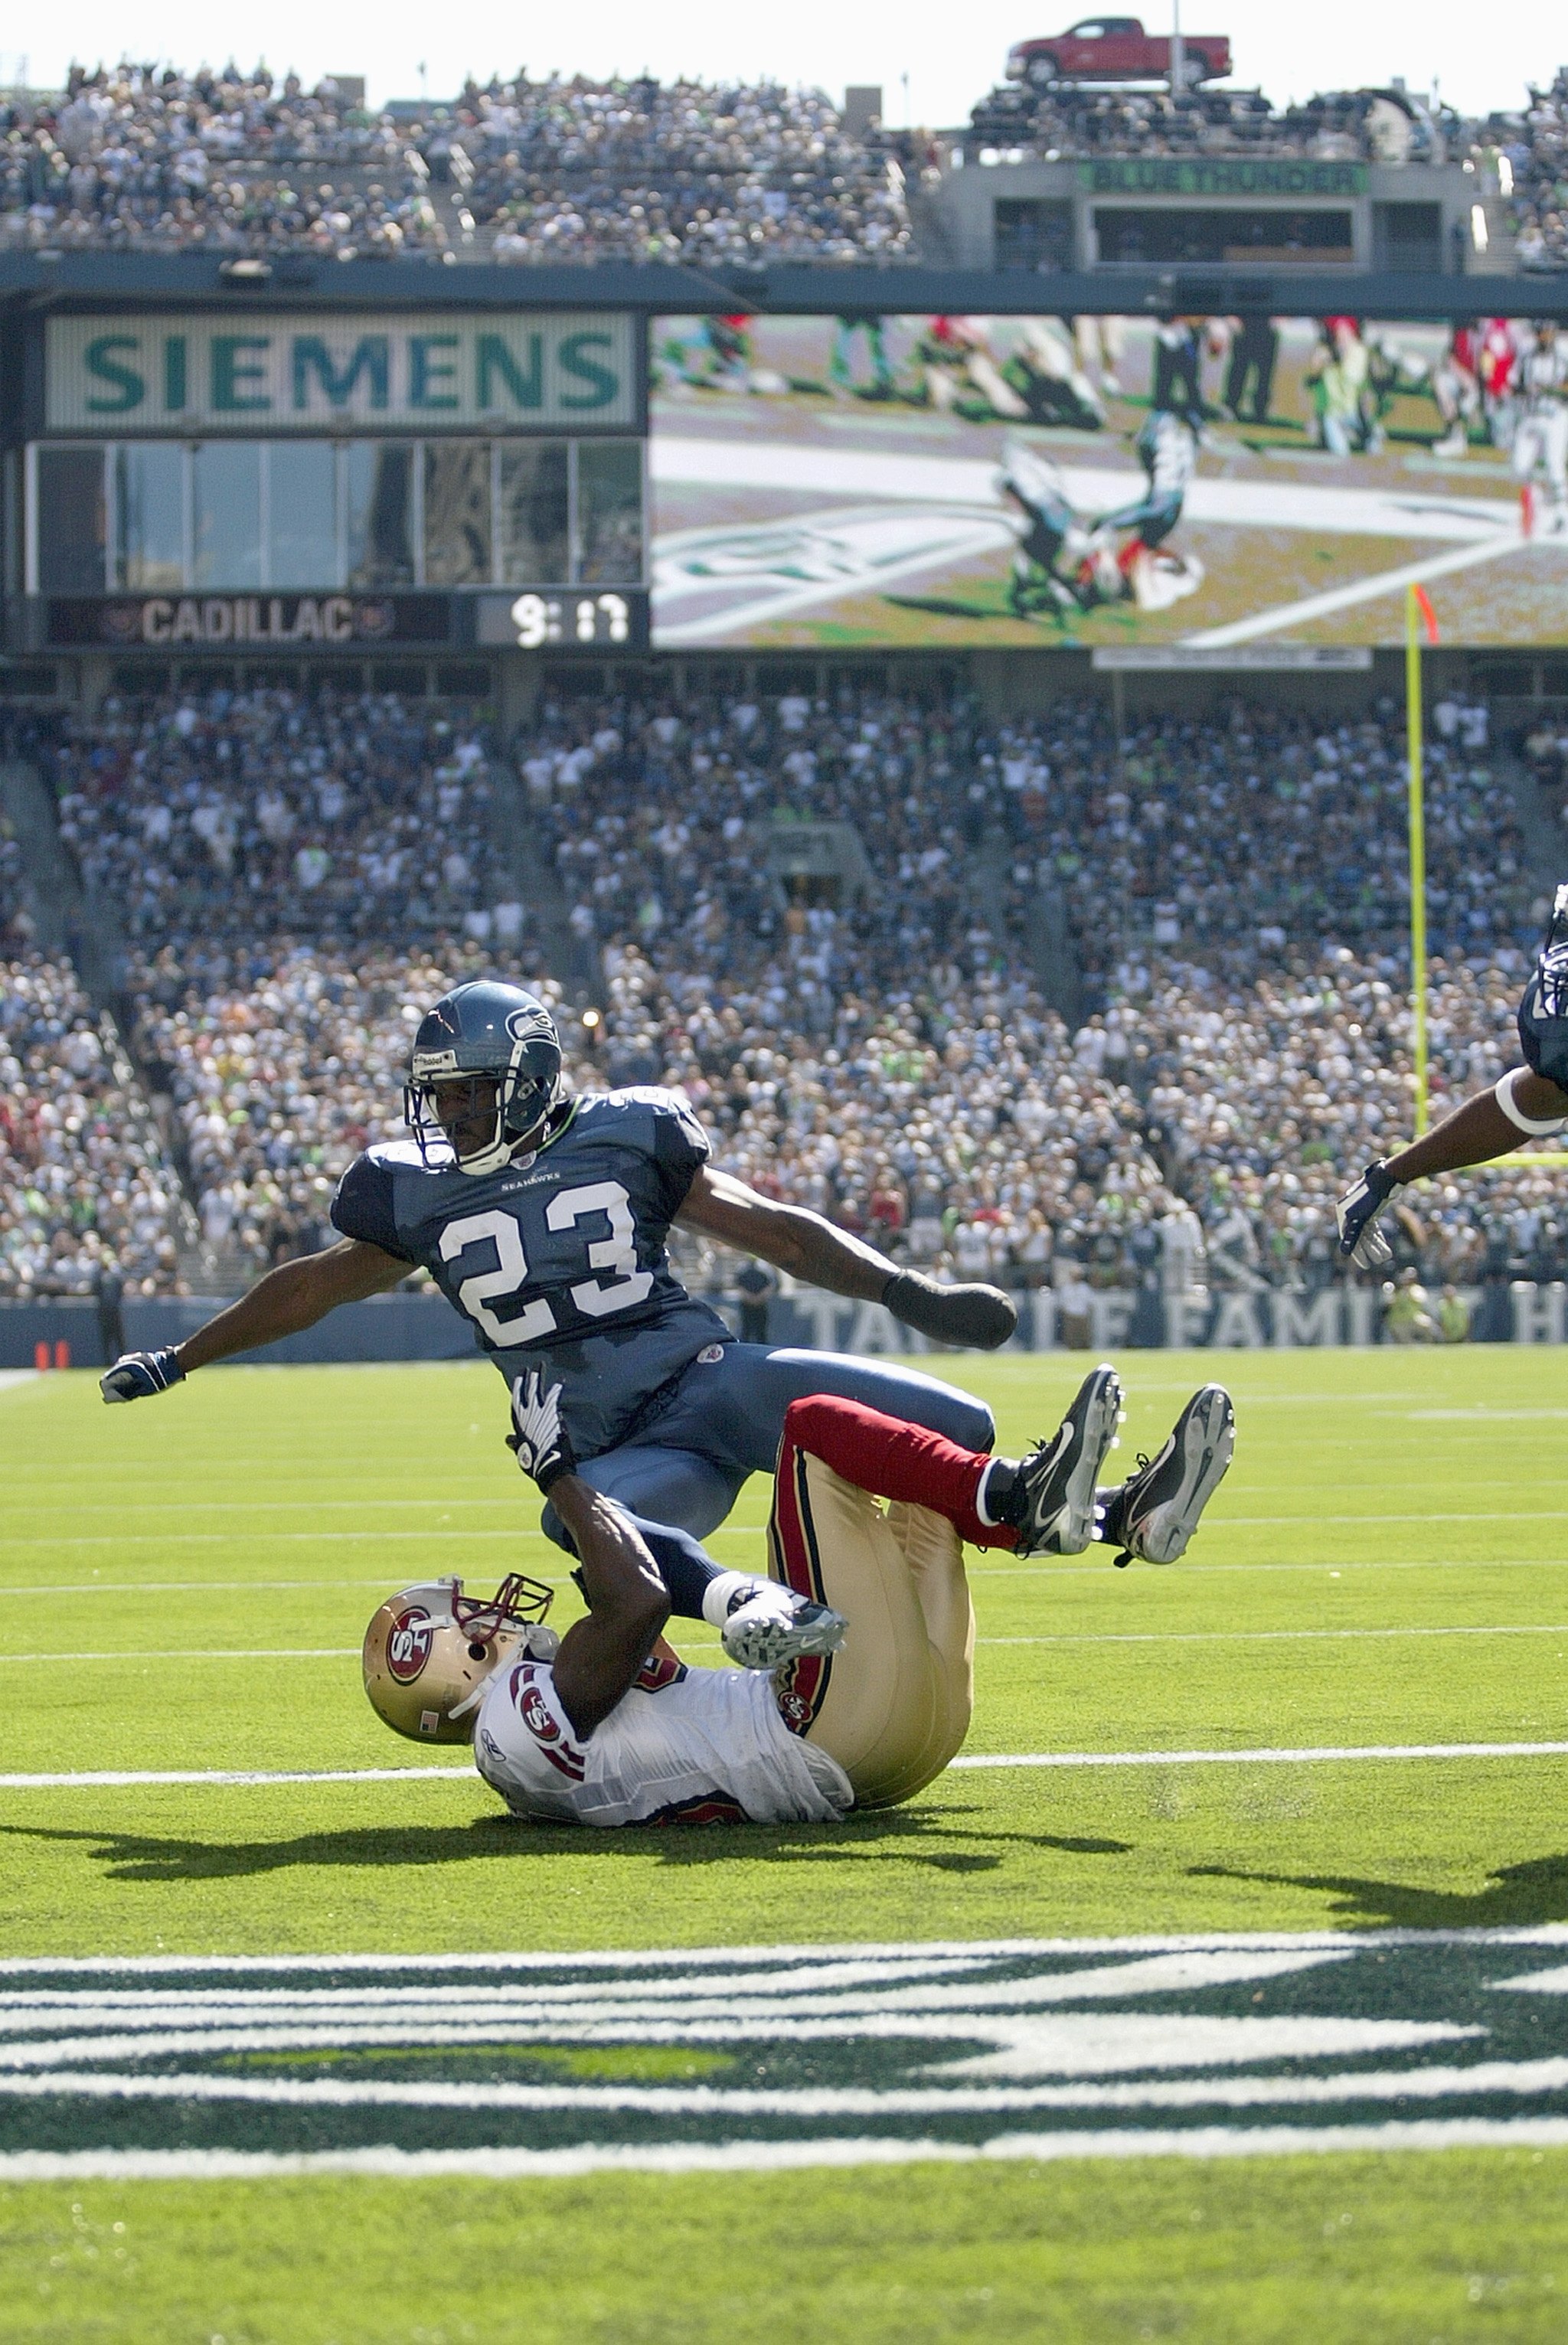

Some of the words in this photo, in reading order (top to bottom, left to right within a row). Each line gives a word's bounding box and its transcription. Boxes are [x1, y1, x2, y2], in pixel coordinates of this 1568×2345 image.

[1093, 165, 1181, 191] BLUE
[1192, 165, 1354, 191] THUNDER
[84, 333, 620, 413] SIEMENS
[142, 598, 354, 642] CADILLAC
[511, 593, 629, 649] 9:17
[439, 1181, 655, 1347] 23
